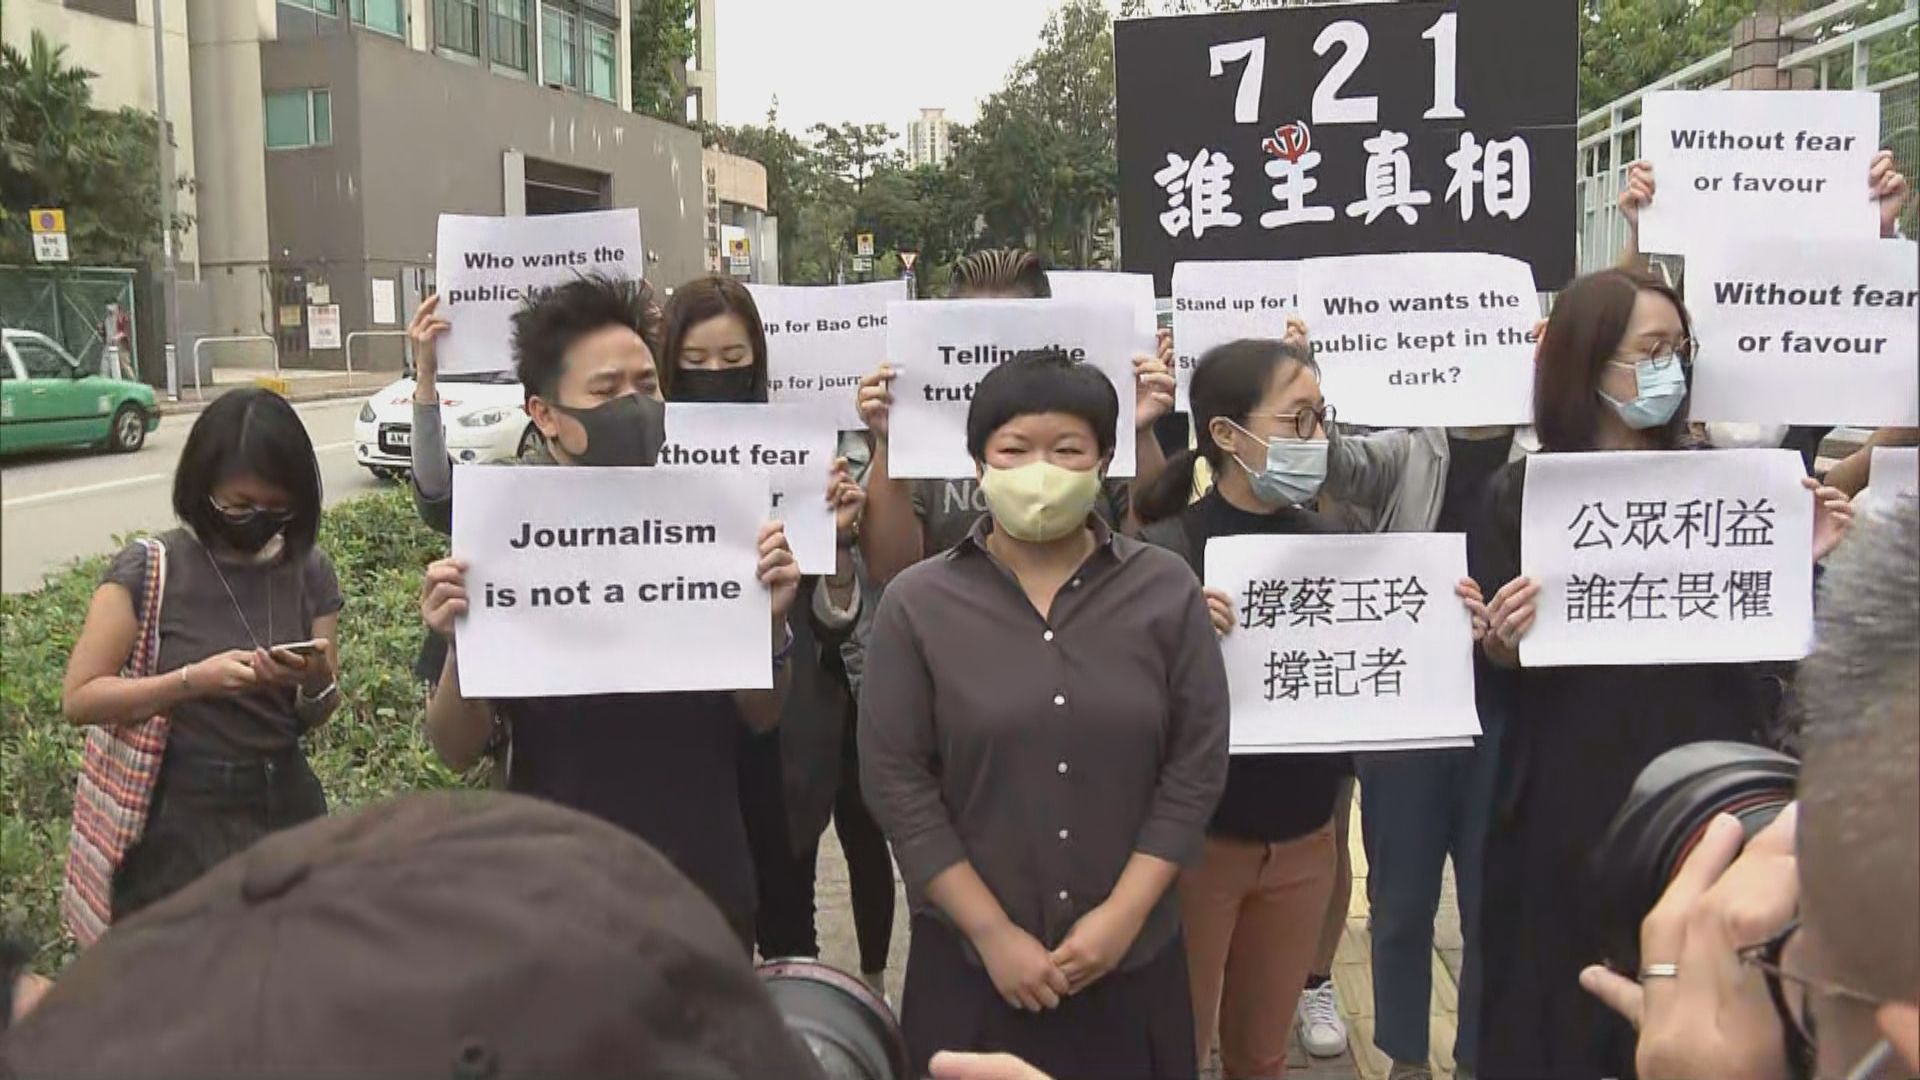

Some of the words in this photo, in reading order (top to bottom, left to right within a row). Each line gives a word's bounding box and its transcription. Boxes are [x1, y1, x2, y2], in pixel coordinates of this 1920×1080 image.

[1670, 129, 1785, 151] Without
[1795, 130, 1856, 151] fear
[1153, 129, 1531, 239] 誰主真相
[1693, 175, 1723, 191] or
[1732, 172, 1827, 193] favour
[464, 252, 514, 269] Who
[522, 249, 588, 267] wants
[594, 246, 625, 262] the
[449, 285, 520, 305] public
[1176, 296, 1227, 311] Stand
[1233, 298, 1255, 312] up
[1260, 296, 1288, 308] for
[1323, 297, 1380, 315] Who
[1388, 292, 1470, 312] wants
[1479, 290, 1519, 308] the
[1714, 282, 1842, 305] Without
[1852, 284, 1919, 307] fear
[785, 320, 811, 333] for
[816, 319, 851, 332] Bao
[1310, 333, 1388, 354] public
[1397, 330, 1456, 351] kept
[1464, 328, 1487, 346] in
[1496, 327, 1538, 346] the
[1738, 335, 1772, 352] or
[1780, 330, 1888, 353] favour
[937, 345, 1015, 364] Tellin
[788, 376, 813, 389] for
[1388, 366, 1461, 385] dark?
[660, 444, 740, 465] thout
[750, 444, 810, 465] fear
[510, 519, 717, 549] Journalism
[1568, 497, 1776, 550] 公眾利益
[485, 582, 517, 608] is
[531, 580, 591, 607] not
[603, 584, 625, 604] a
[638, 576, 741, 603] crime
[1566, 570, 1774, 622] 誰在畏懼
